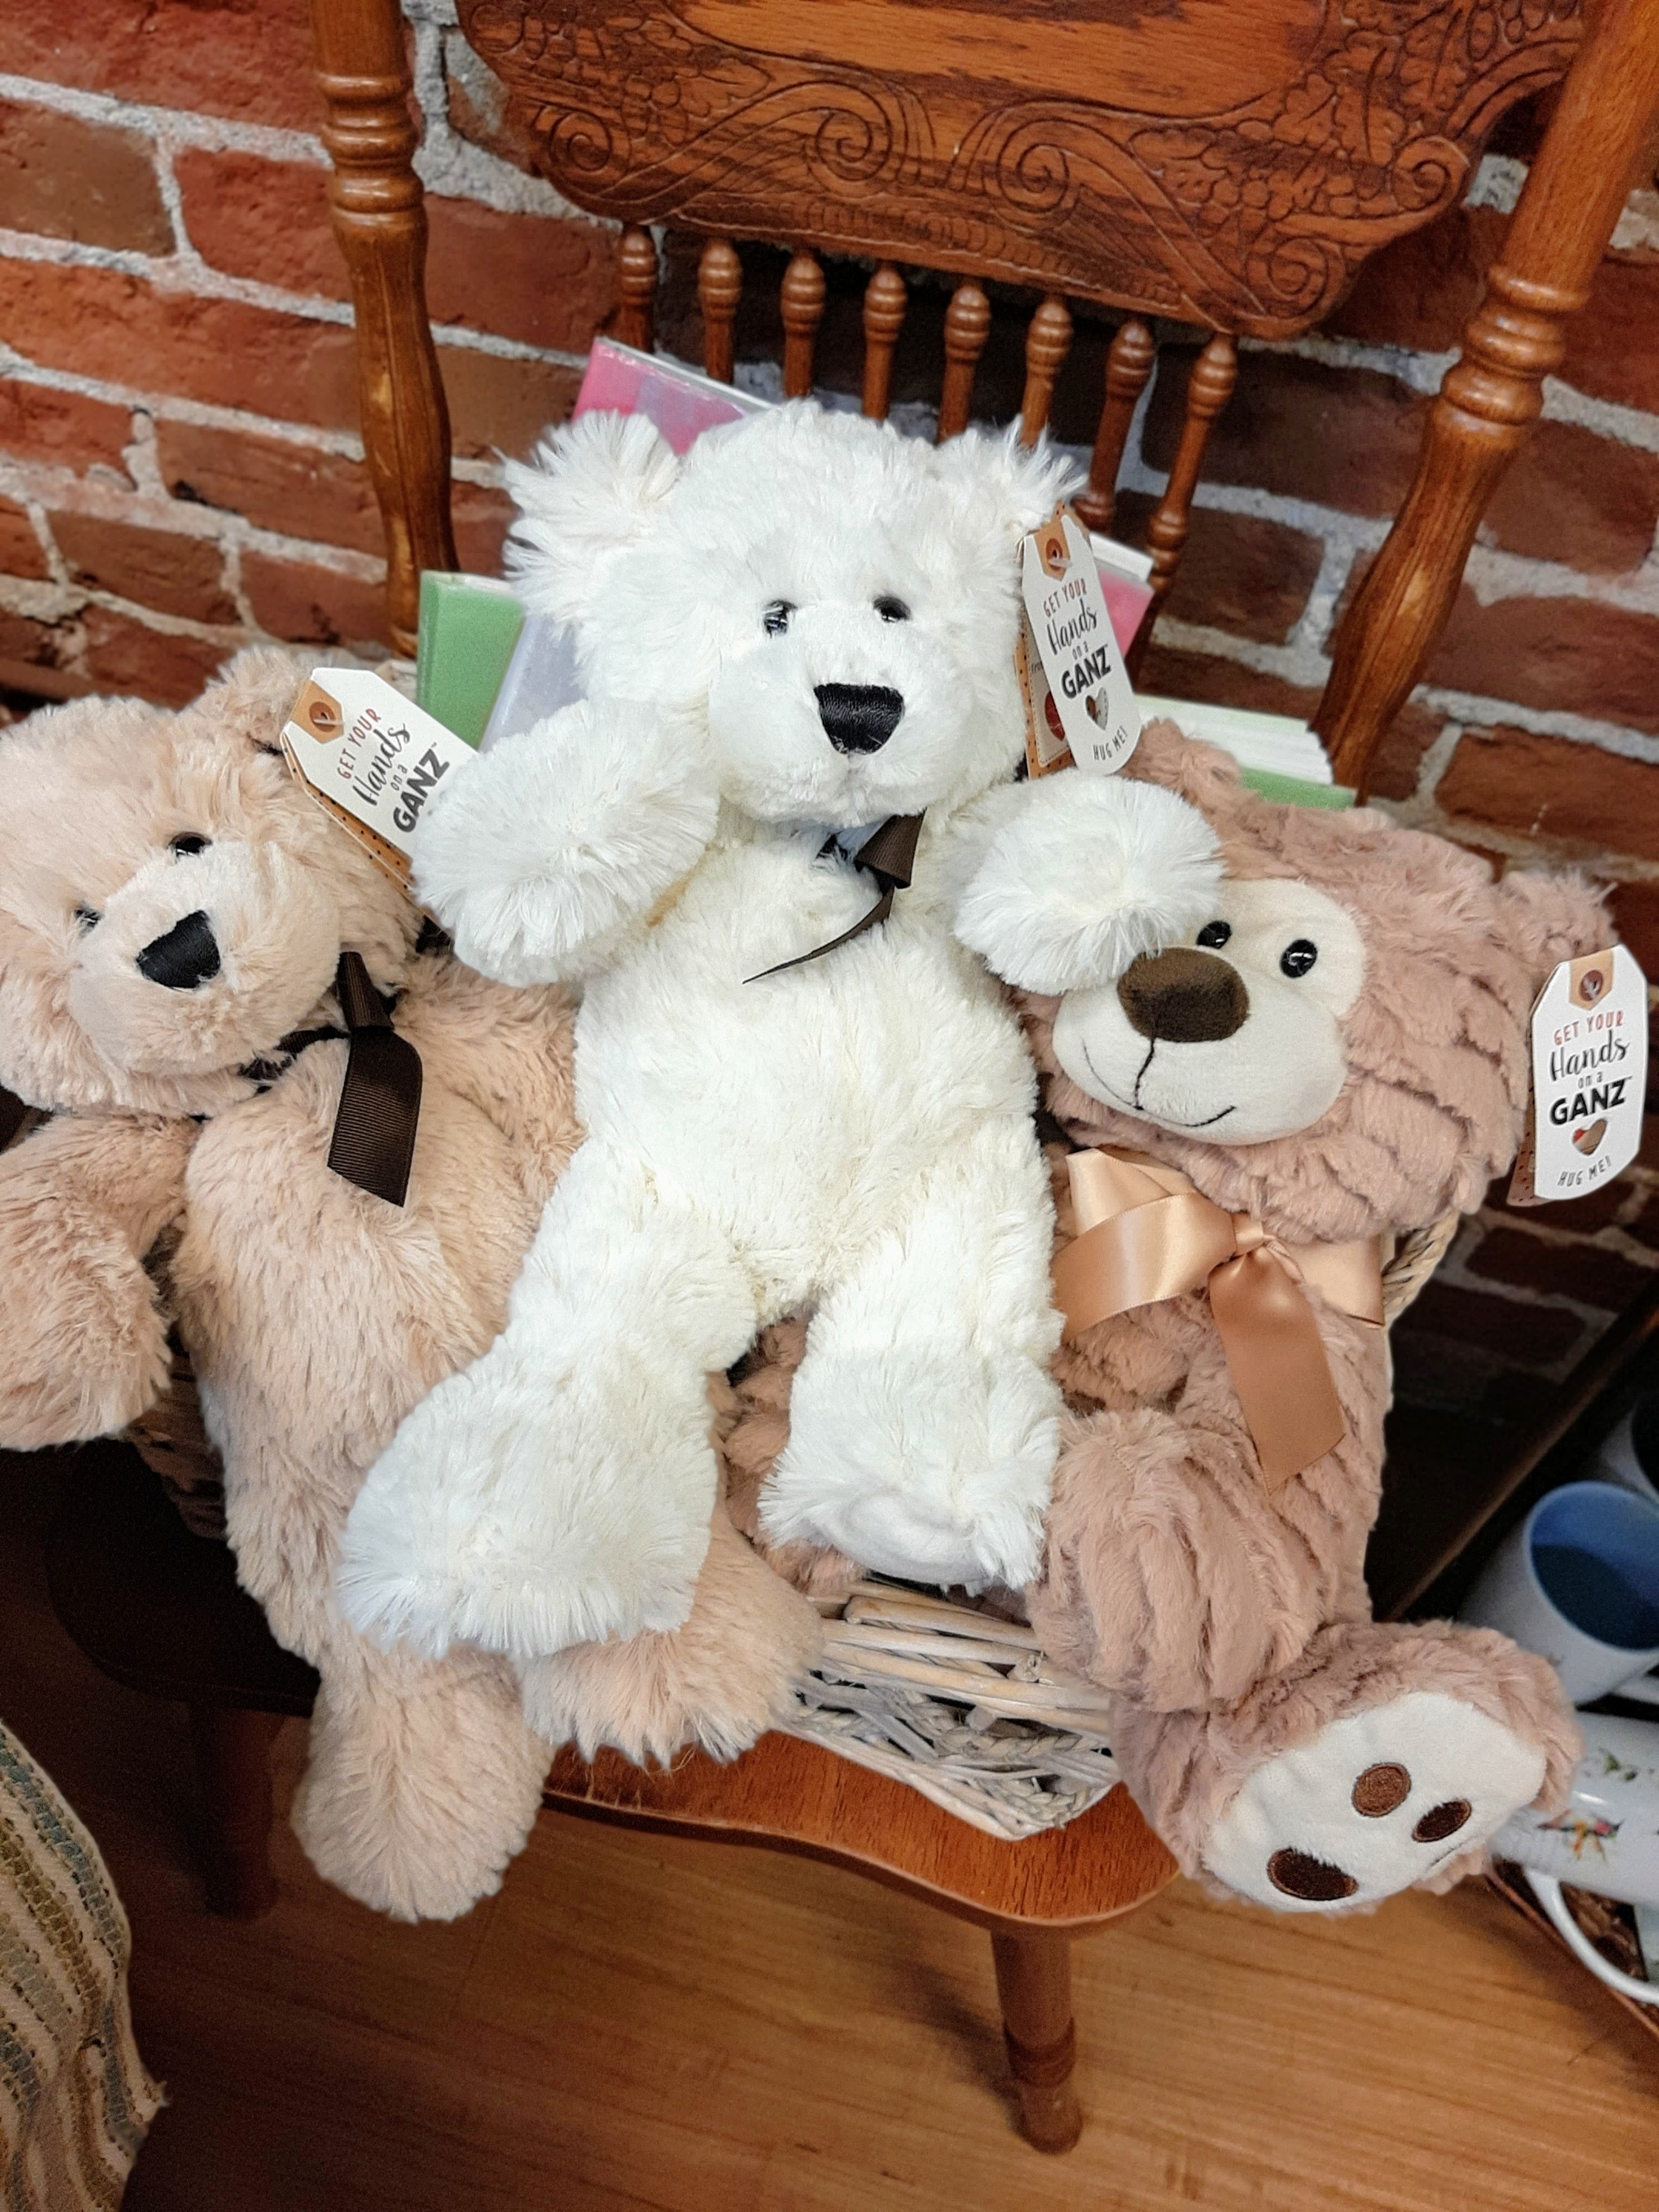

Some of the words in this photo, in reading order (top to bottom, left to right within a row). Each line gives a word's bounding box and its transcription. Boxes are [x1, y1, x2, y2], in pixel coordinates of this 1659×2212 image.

[1043, 590, 1060, 617] GET
[1062, 578, 1087, 601] YOUR
[1047, 597, 1098, 656] Hands
[1072, 648, 1082, 660] on
[1083, 641, 1089, 653] a
[337, 748, 356, 779] GET
[347, 708, 382, 747] YOUR
[1093, 742, 1112, 760] HUG
[1112, 725, 1128, 751] ME!
[352, 723, 411, 806] Hands
[391, 776, 404, 791] on
[398, 764, 408, 775] a
[1554, 1021, 1579, 1046] GET
[1587, 1010, 1624, 1034] YOUR
[1549, 1029, 1630, 1081] Hands
[1578, 1075, 1593, 1089] on
[1596, 1071, 1603, 1083] a
[1557, 1170, 1583, 1187] HUG
[1588, 1155, 1613, 1182] ME!
